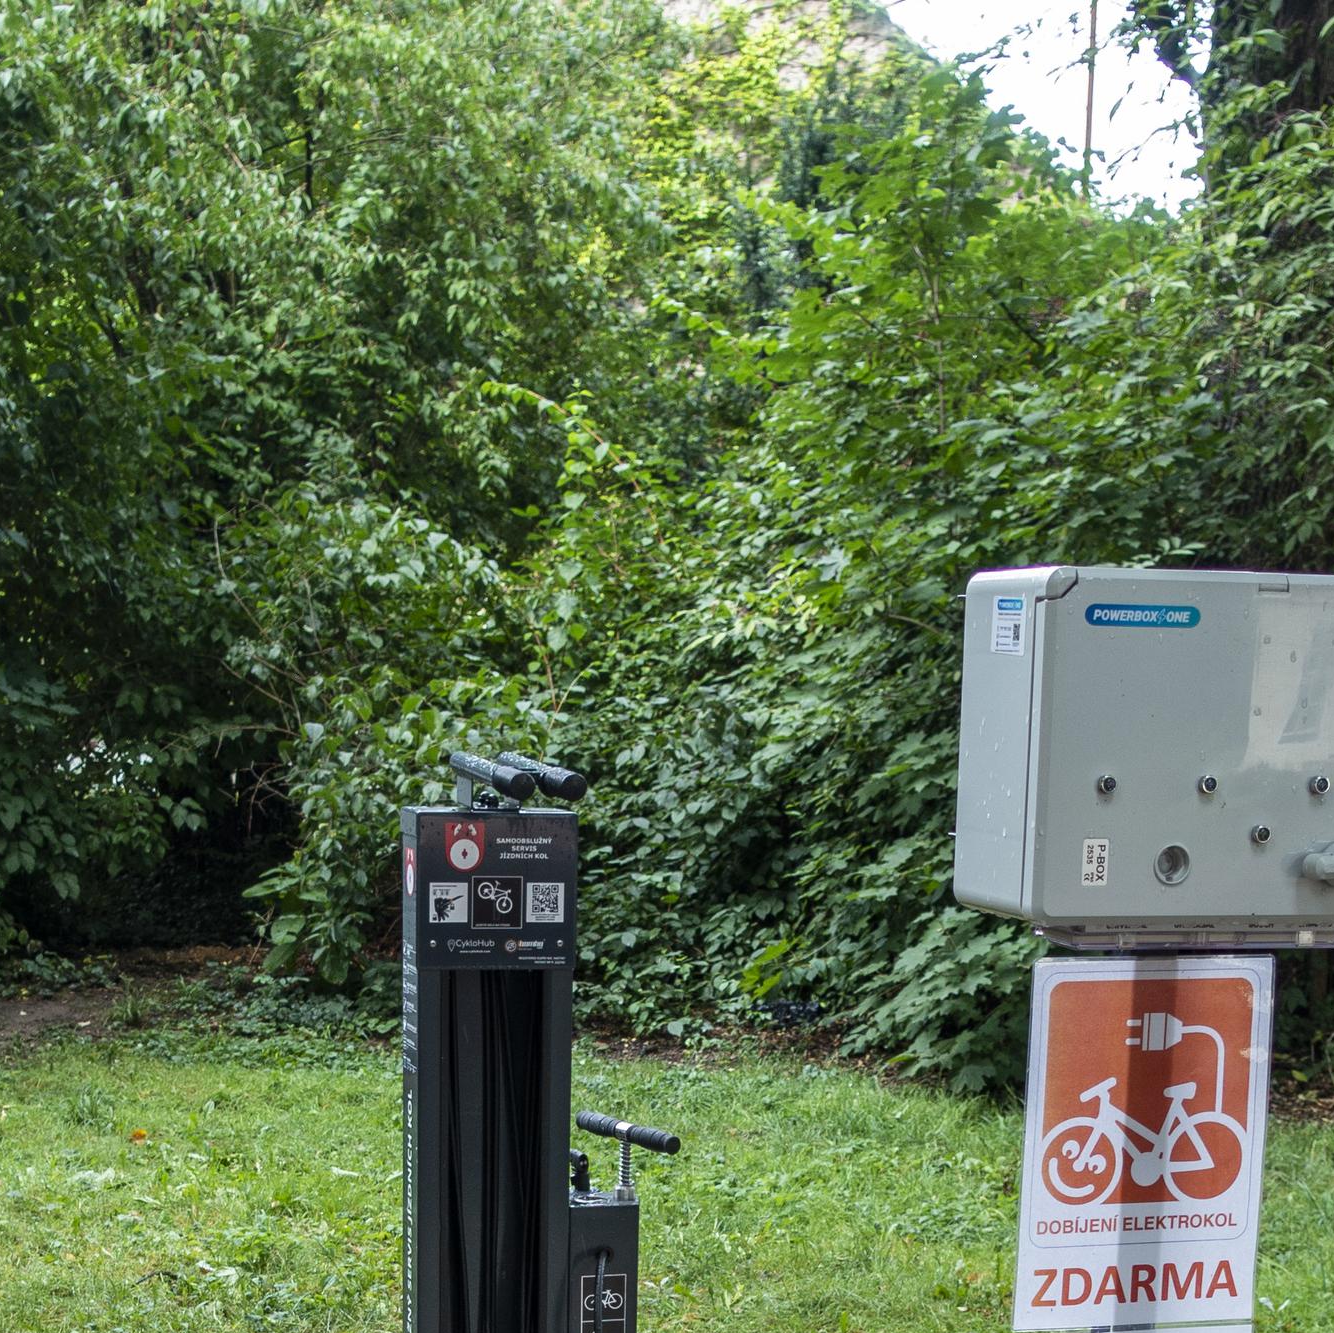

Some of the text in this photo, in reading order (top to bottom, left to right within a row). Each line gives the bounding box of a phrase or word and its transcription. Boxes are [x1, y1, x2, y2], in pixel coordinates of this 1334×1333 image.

[1093, 608, 1191, 623] POWERBOX ONE
[496, 836, 552, 844] SAMOOBSLUŽNÝ
[499, 852, 533, 860] JÍZDNÍCH
[1086, 845, 1094, 864] 2535
[1096, 844, 1106, 881] P-BOX
[455, 939, 495, 949] CykloHub
[1037, 1213, 1237, 1235] DOBÍJENÍ ELEKTROKOL
[1031, 1260, 1238, 1307] ZDARMA
